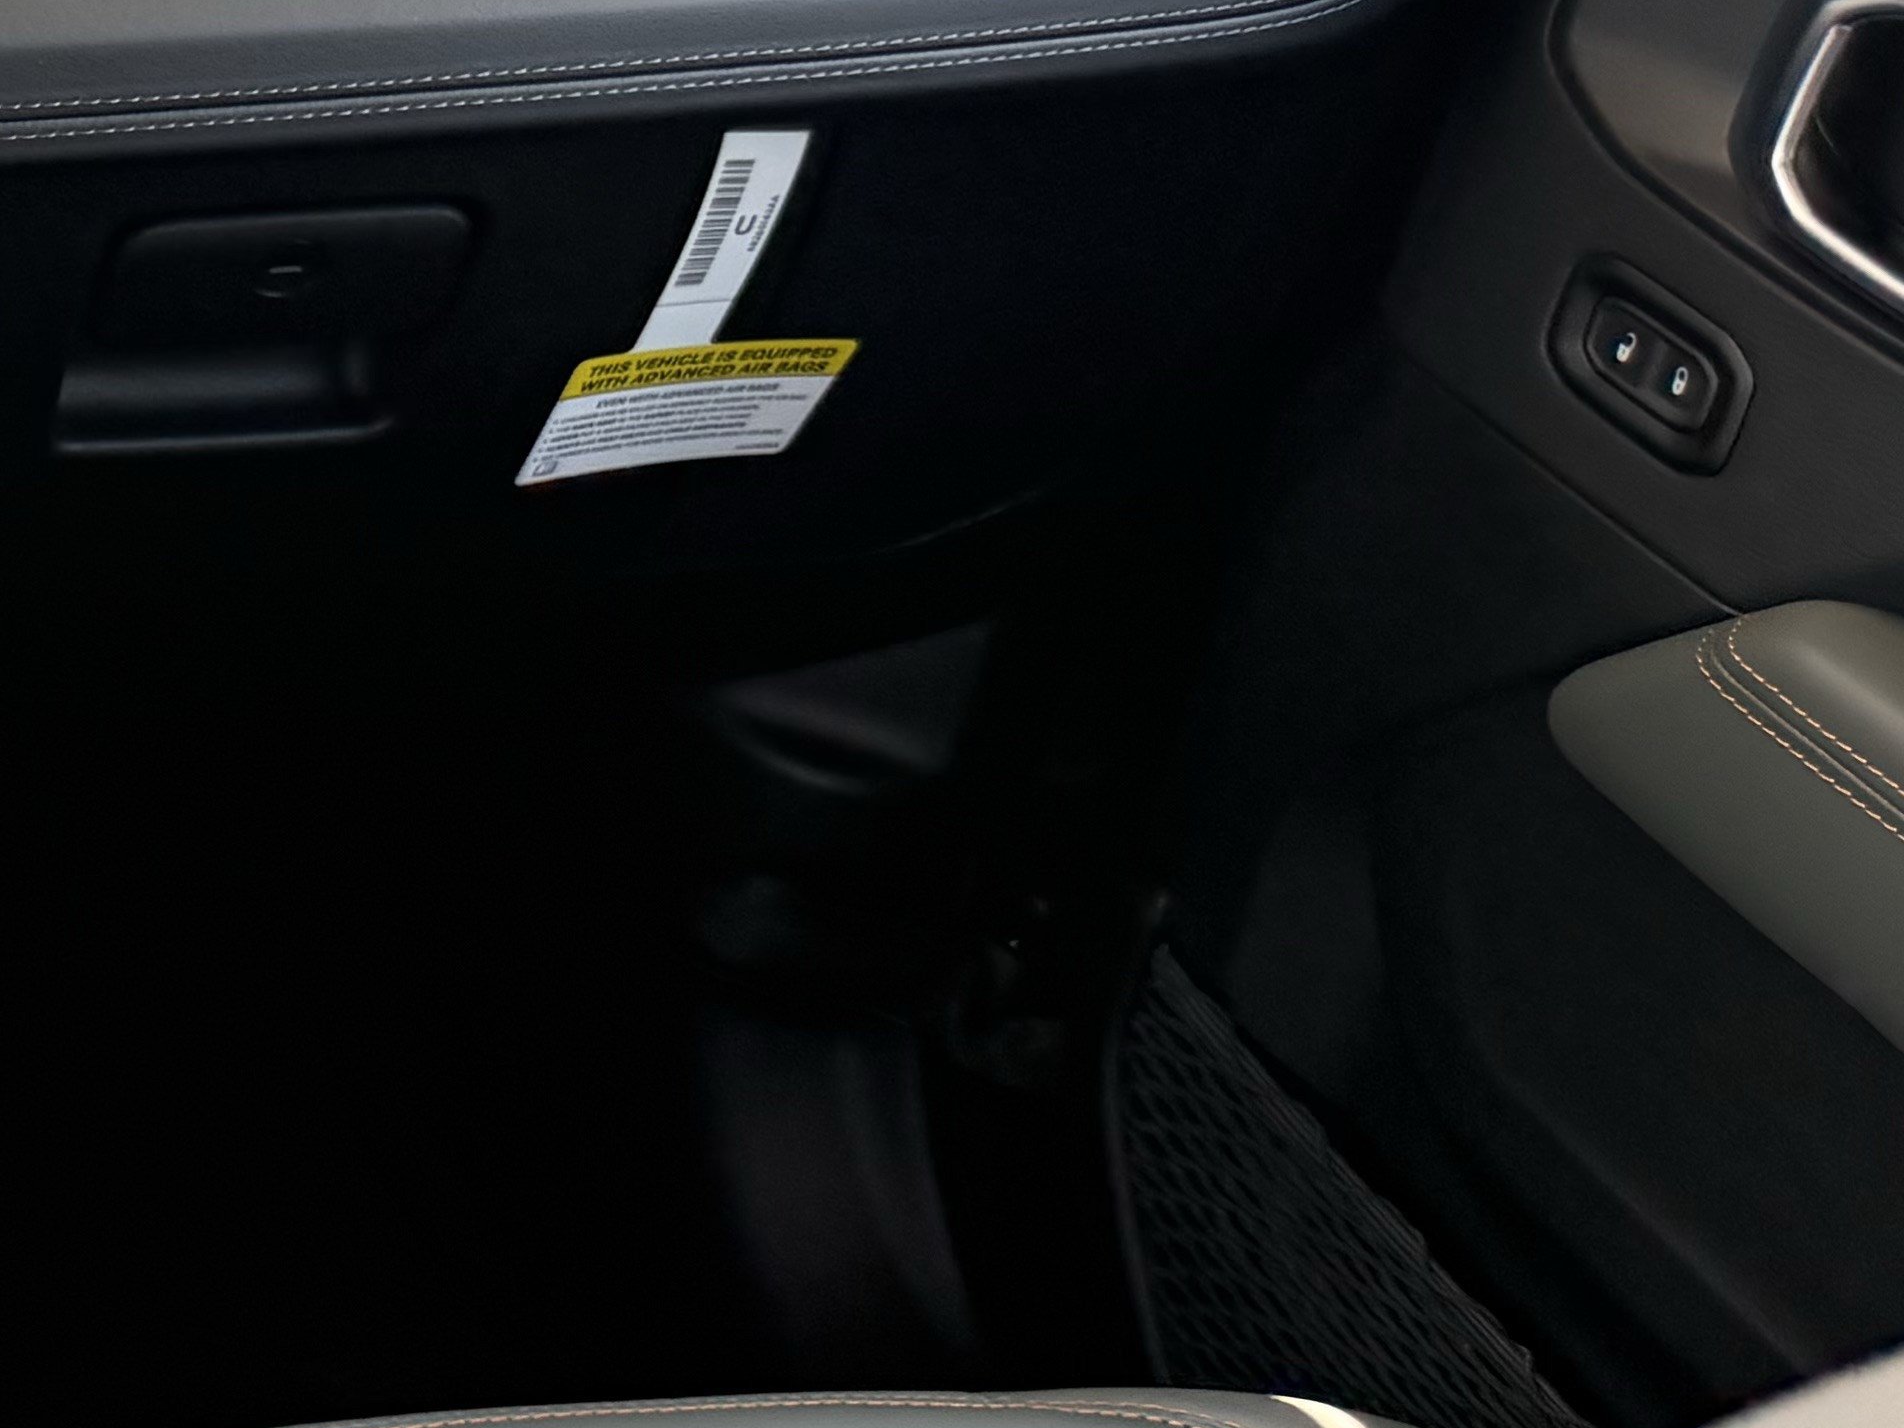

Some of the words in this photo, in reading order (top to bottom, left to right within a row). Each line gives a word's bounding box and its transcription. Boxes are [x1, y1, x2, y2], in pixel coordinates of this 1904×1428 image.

[580, 373, 630, 394] WITH
[630, 364, 736, 388] ADVANCED
[739, 362, 774, 376] AIR
[774, 360, 830, 375] BAGS
[589, 362, 630, 377] THIS
[635, 352, 713, 371] VEHICLE
[742, 347, 839, 362] EQUIPPED
